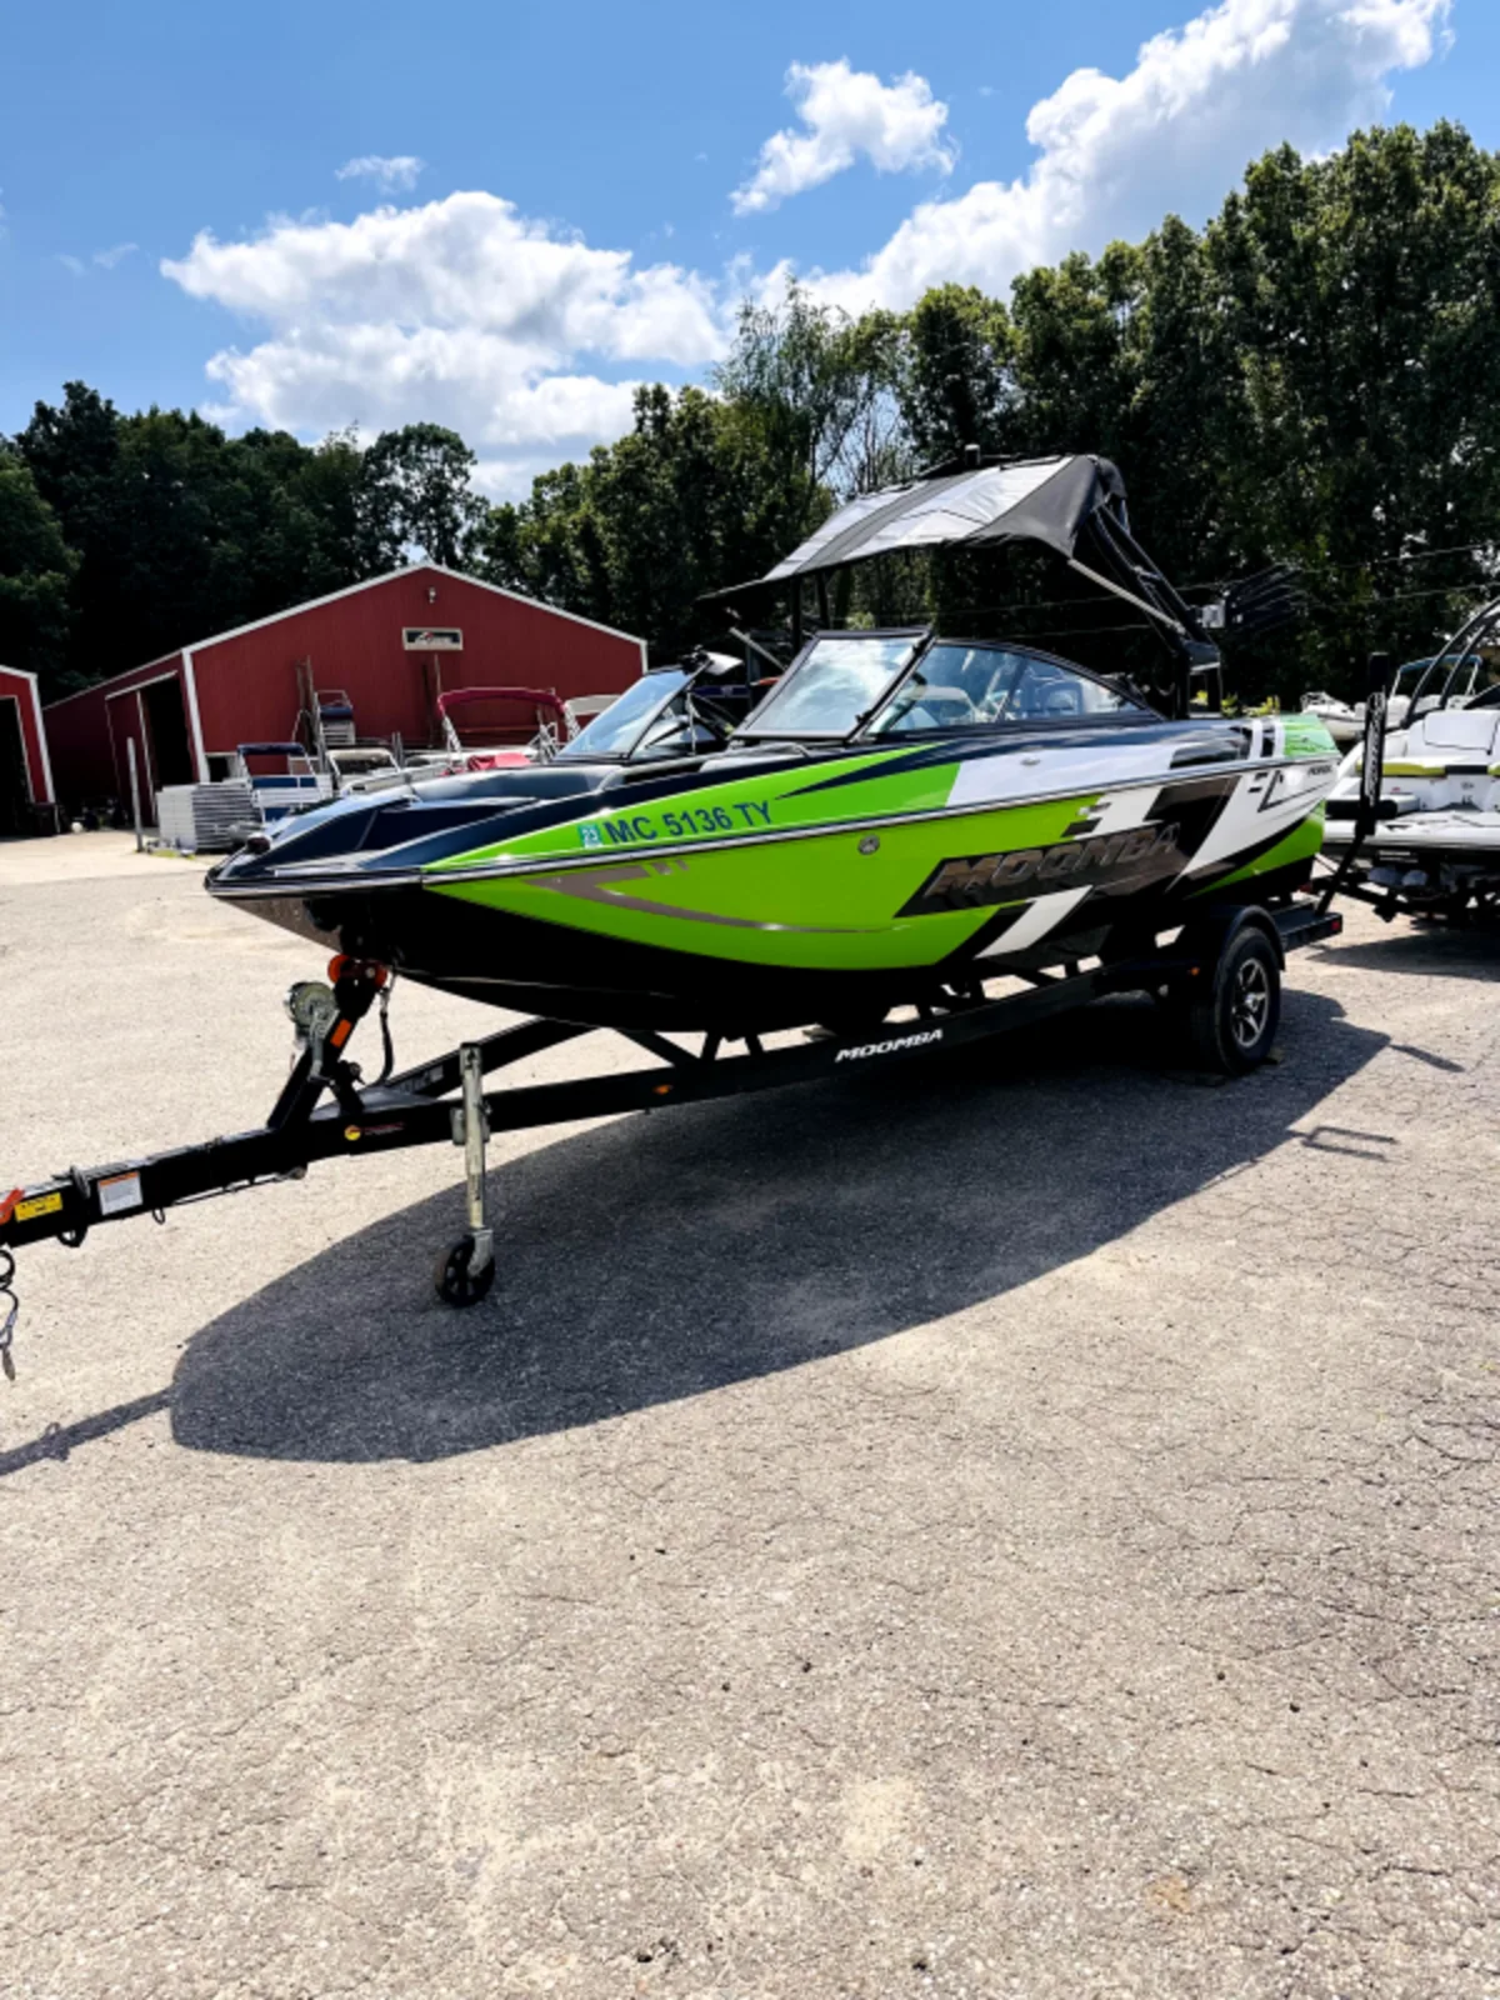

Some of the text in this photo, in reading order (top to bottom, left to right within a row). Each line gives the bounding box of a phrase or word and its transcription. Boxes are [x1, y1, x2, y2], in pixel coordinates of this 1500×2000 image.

[603, 800, 772, 843] MC 5136 TY
[923, 822, 1181, 898] MOOMBA
[835, 1028, 943, 1063] MOOMBA
